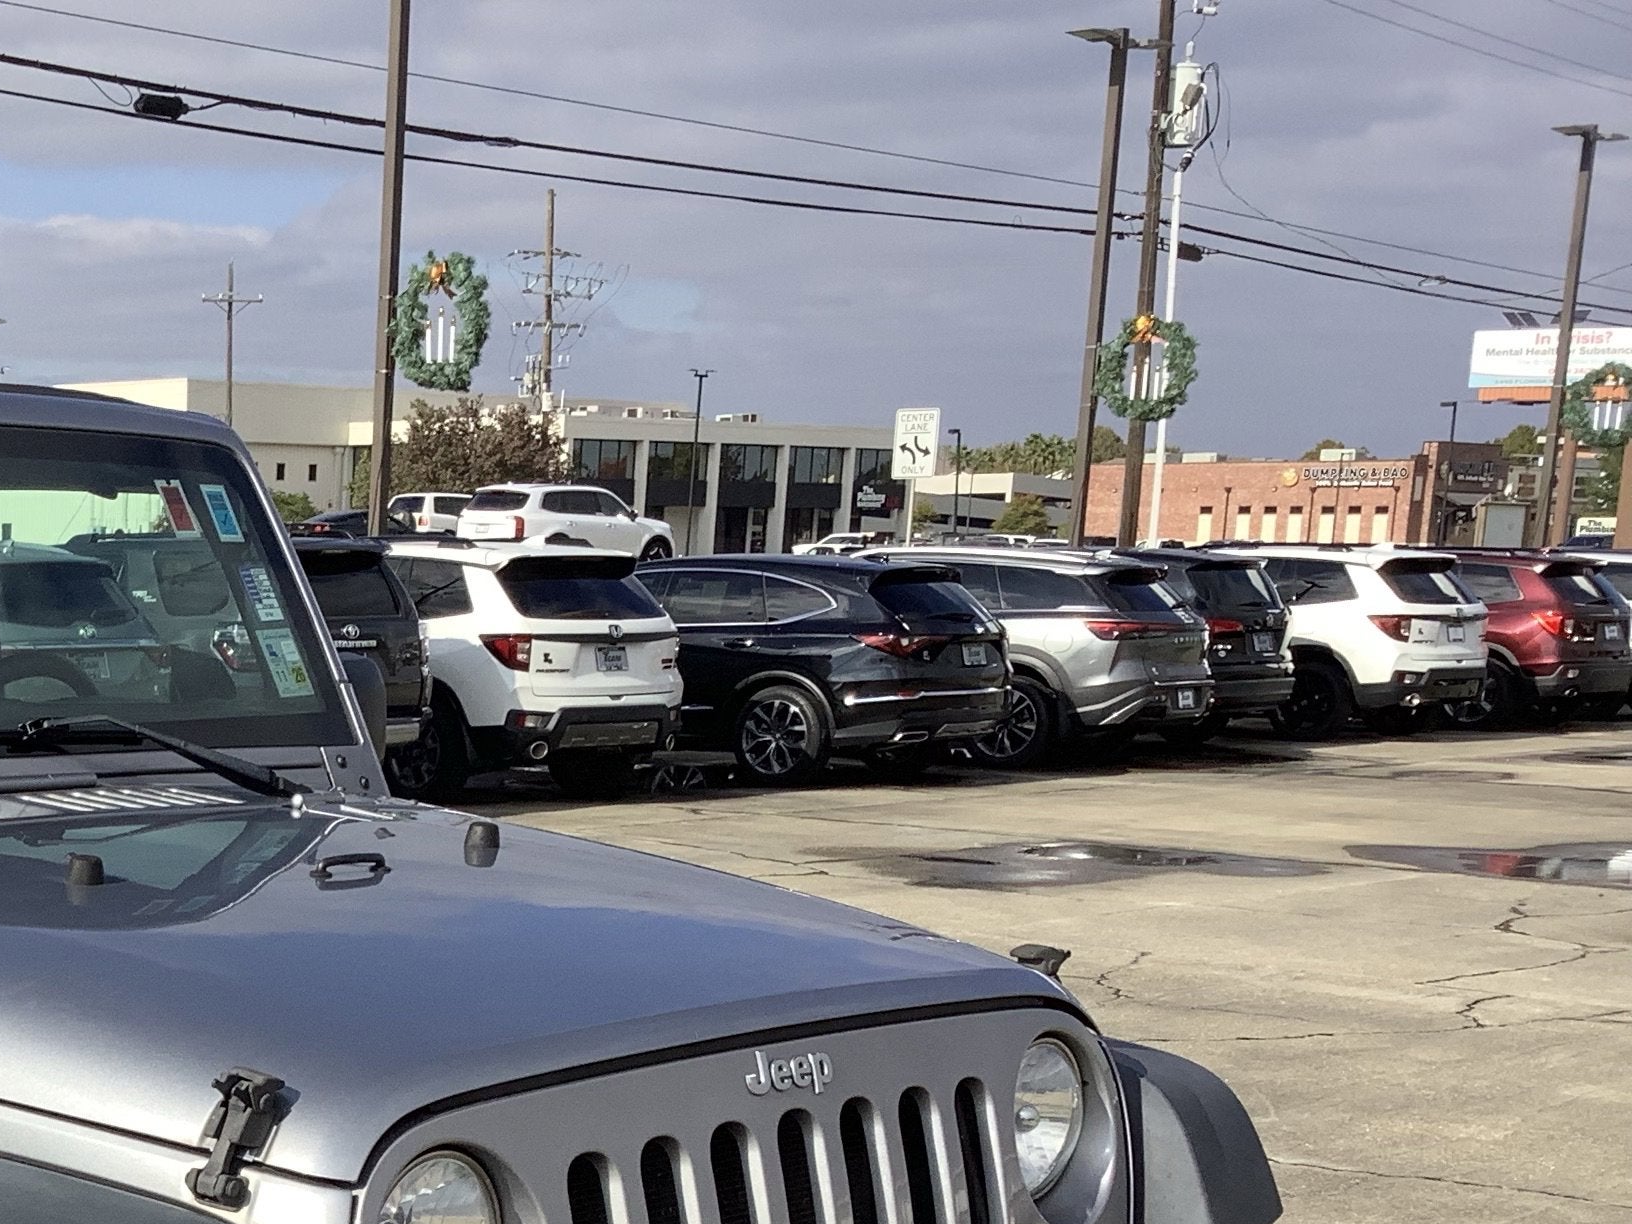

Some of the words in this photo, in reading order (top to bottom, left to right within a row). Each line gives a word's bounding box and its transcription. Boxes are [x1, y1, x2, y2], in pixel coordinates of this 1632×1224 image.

[1535, 333, 1551, 345] In
[1485, 347, 1522, 357] Mental
[901, 413, 935, 423] CENTER
[905, 423, 928, 432] LANE
[901, 466, 926, 475] ONLY
[1382, 467, 1409, 479] BAO
[275, 669, 288, 683] 11
[744, 1050, 834, 1096] Jeep
